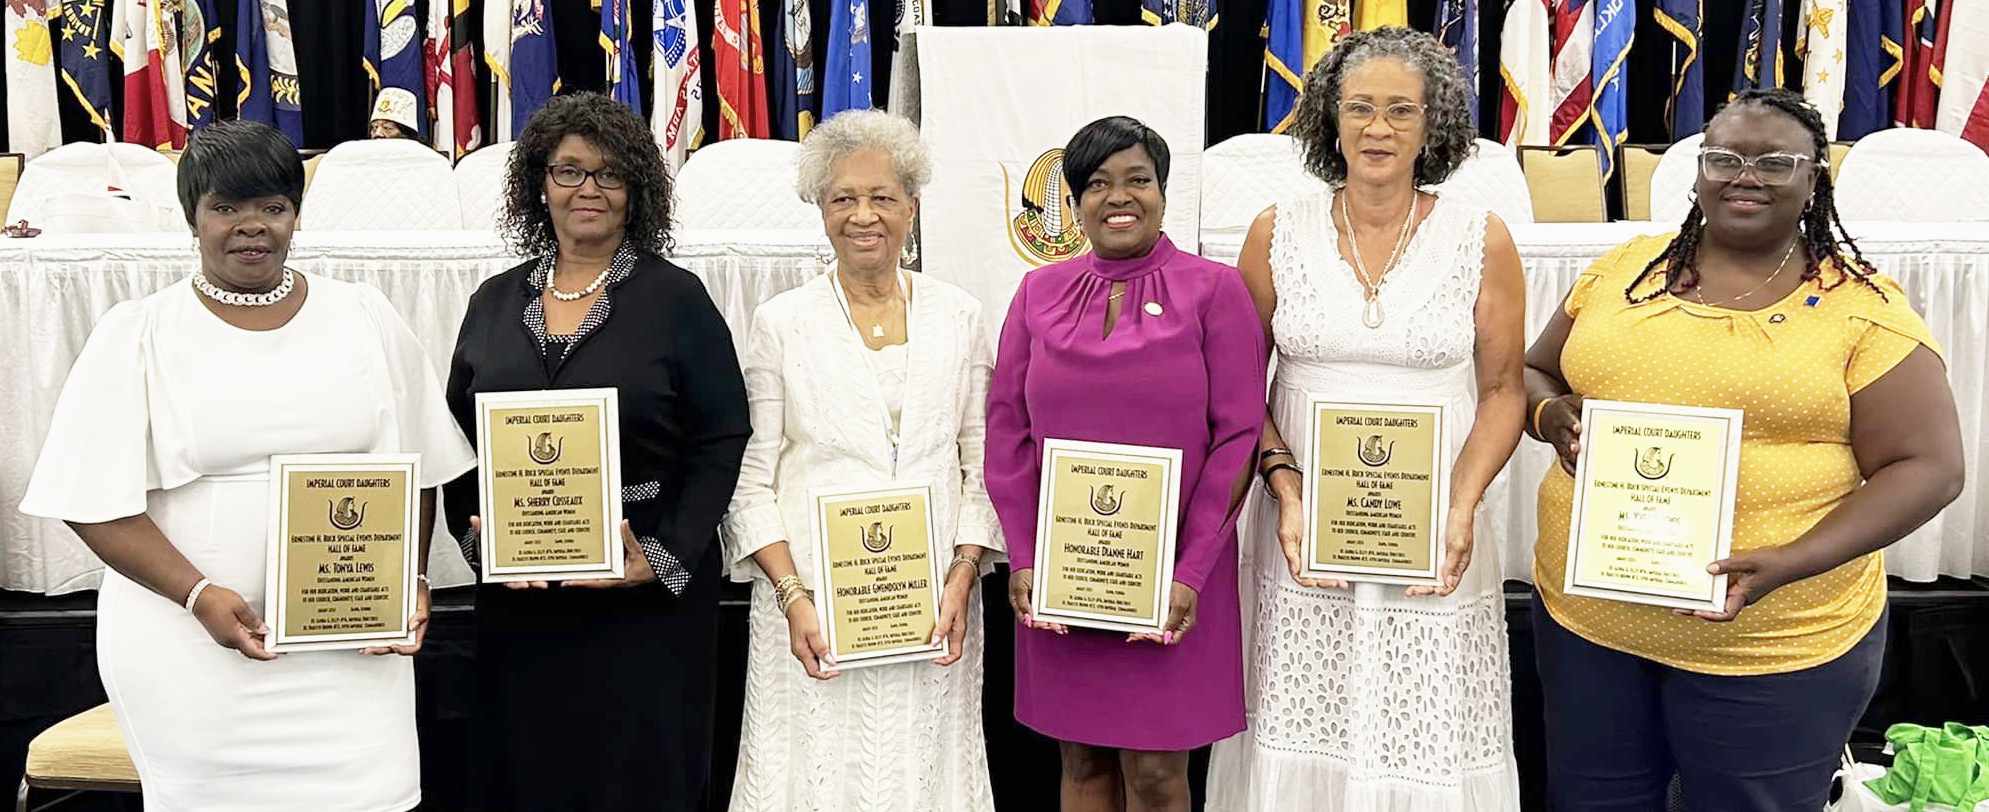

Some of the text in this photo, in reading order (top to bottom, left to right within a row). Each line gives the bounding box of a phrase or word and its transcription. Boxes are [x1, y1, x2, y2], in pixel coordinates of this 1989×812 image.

[505, 413, 584, 424] IMPERIAL COURT DAUGHTERS
[1336, 416, 1417, 427] IMPERIAL COURT DAUGHTERS
[1071, 465, 1147, 478] IMPERIAL COURT DAUGHTERS
[1384, 471, 1399, 479] EVENTS
[1401, 472, 1429, 480] DEPARTMENT
[306, 479, 390, 488] IMPERIAL COURT DAUGHTERS
[529, 478, 565, 487] HALL OF FAME
[1356, 480, 1393, 489] HALL OF FAME
[527, 497, 550, 507] SHERRY
[1346, 497, 1401, 509] MS. CANDY LOWE
[839, 502, 911, 516] IMPERIAL COURT DAUGHTERS
[1096, 519, 1112, 527] SPECIAL
[1114, 520, 1128, 528] EVENTS
[1130, 522, 1156, 531] DEPARTMENT
[374, 533, 401, 541] DEPARTMENT
[1087, 528, 1122, 538] HALL OF FAME
[328, 544, 365, 553] HALL OF FAME
[1064, 543, 1143, 559] HONORABLE DIANNE HART
[333, 562, 353, 573] TONYA
[356, 562, 374, 572] LEWIS
[864, 567, 876, 575] HALL
[884, 564, 896, 572] FAME
[836, 585, 870, 597] HONORABLE
[908, 579, 927, 589] MILLER
